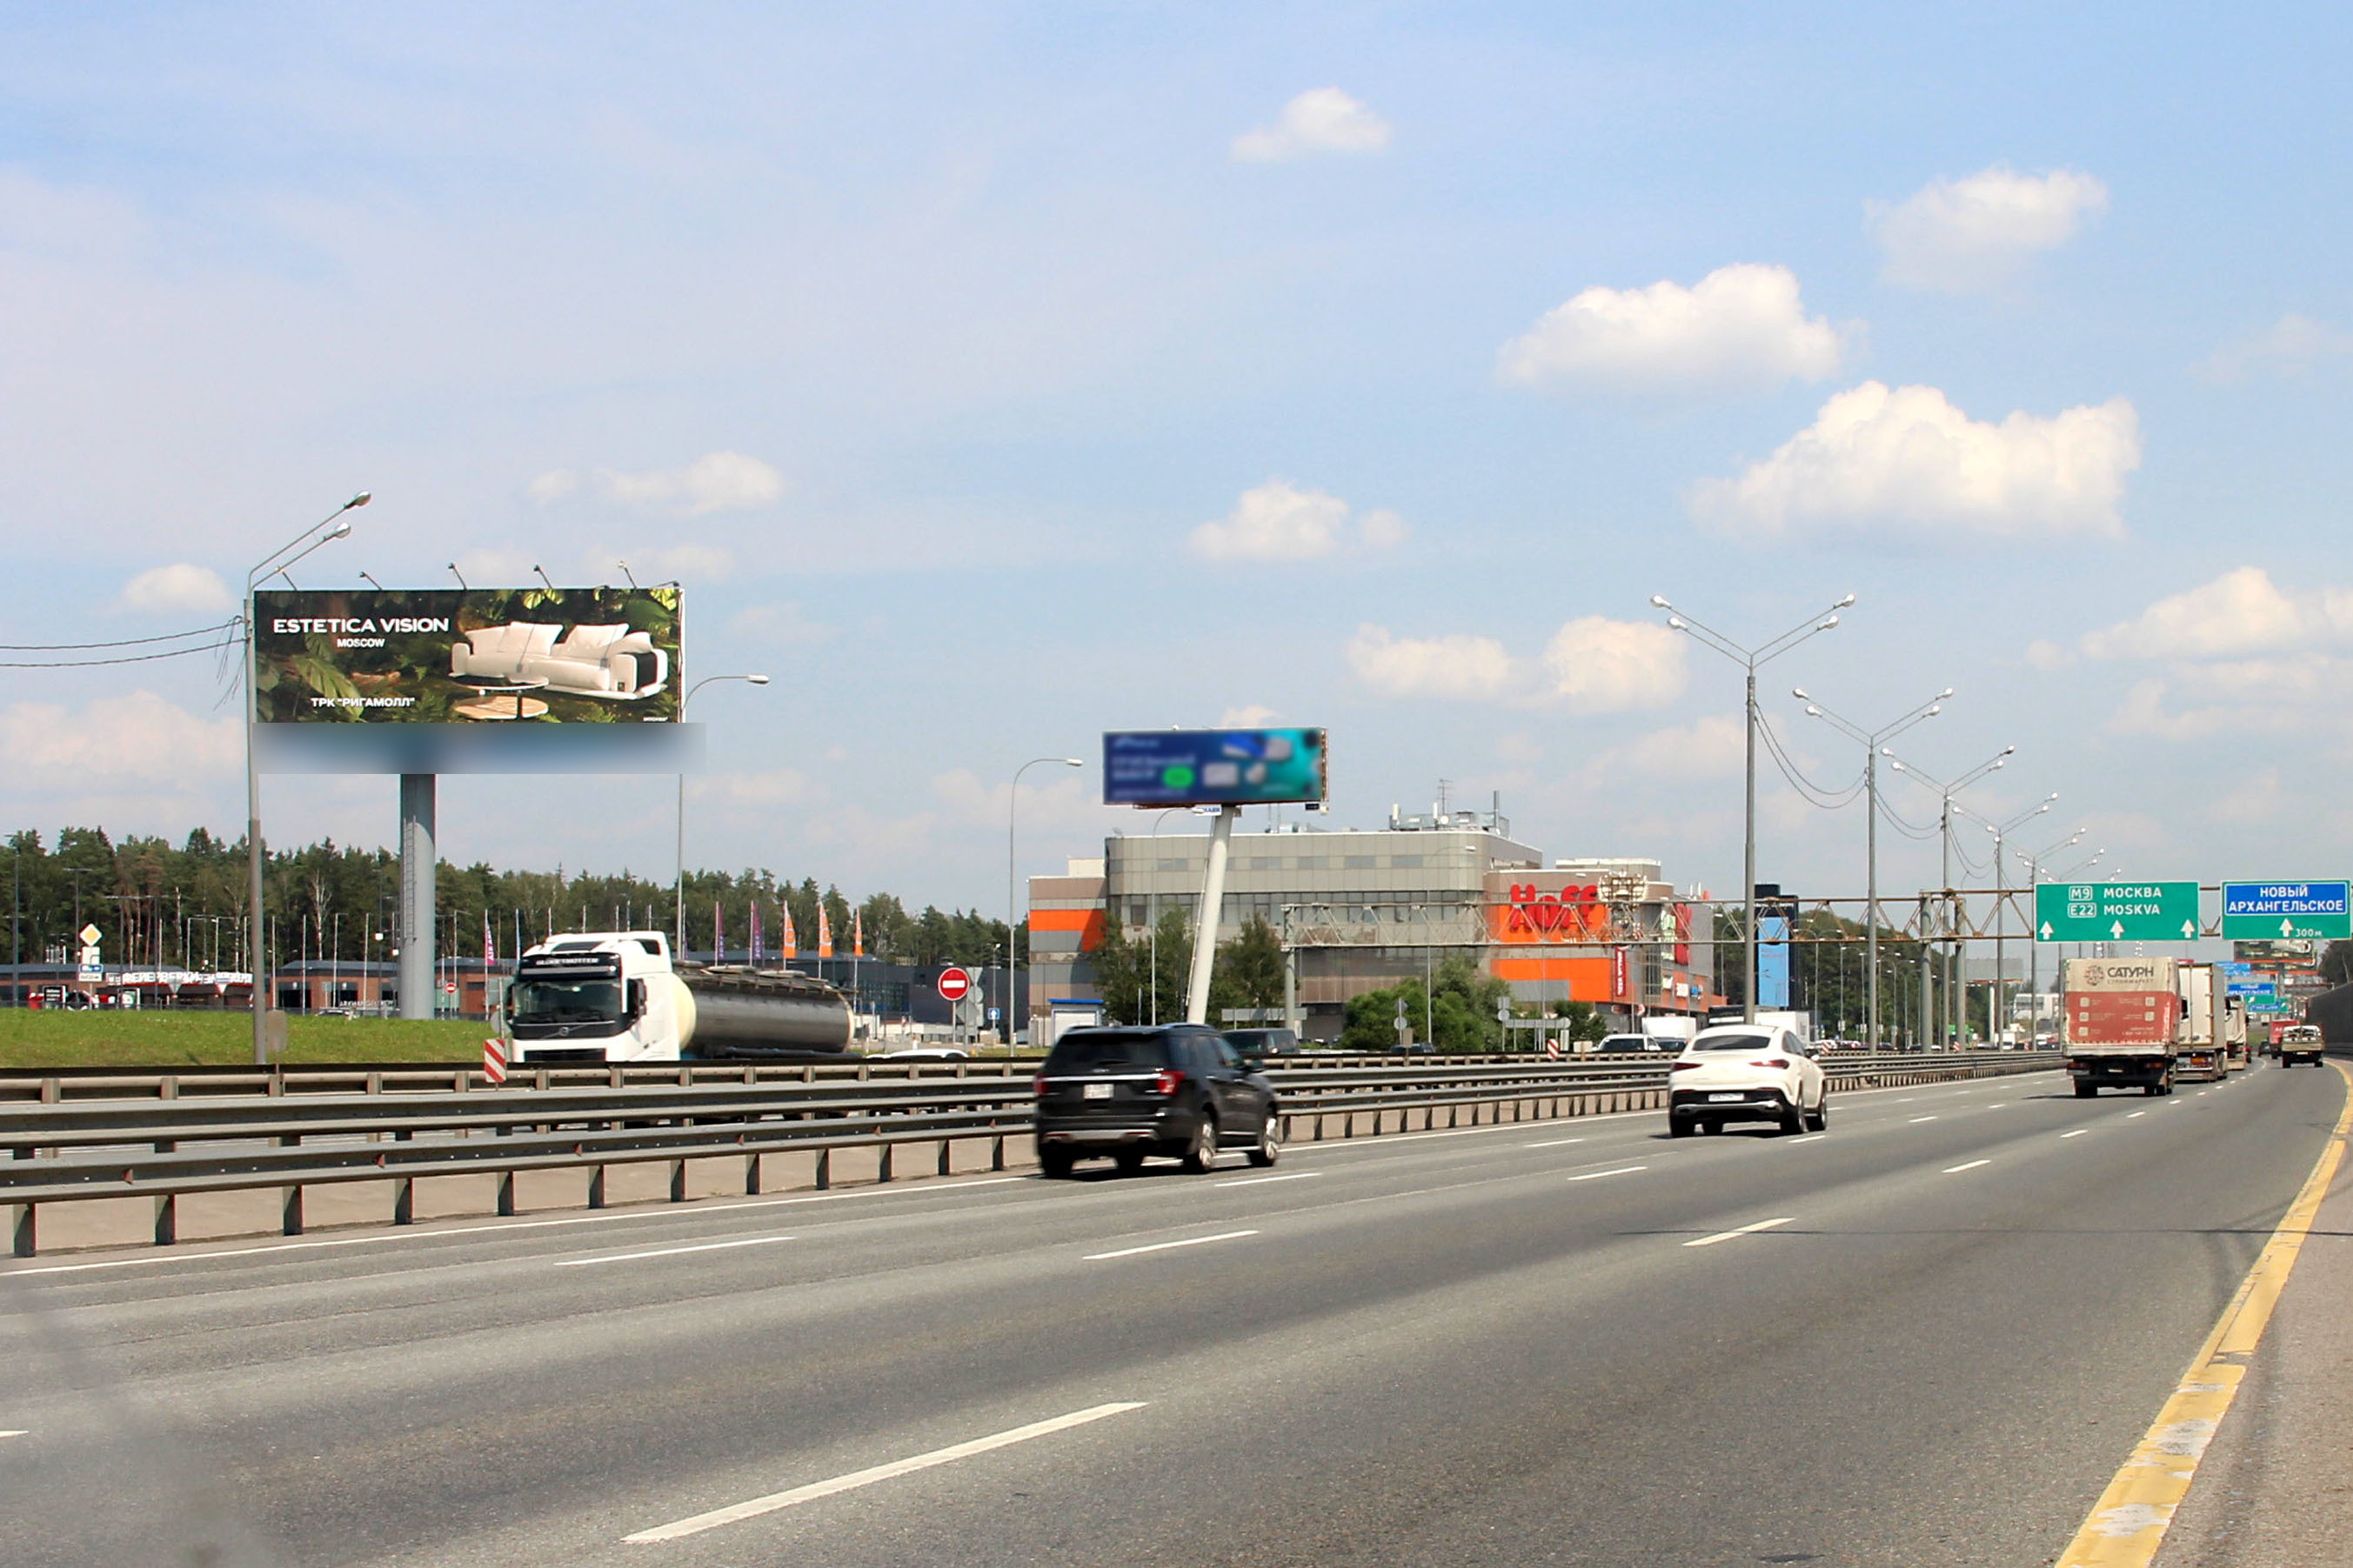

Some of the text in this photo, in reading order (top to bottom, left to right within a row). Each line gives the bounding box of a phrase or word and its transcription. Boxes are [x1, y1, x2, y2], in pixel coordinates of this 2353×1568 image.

[273, 617, 449, 633] ESTETICA VISION
[337, 638, 385, 648] MOSCOW
[311, 697, 416, 708] ТРК "РИГАМОЛЛ"
[2103, 886, 2162, 898] МОСКВА
[2259, 884, 2309, 898] НОВЫЙ
[2070, 904, 2095, 916] E22
[2103, 904, 2161, 916] MOSKVA
[2228, 899, 2344, 912] АРХАНГЕЛЬСКОЕ
[2107, 966, 2155, 977] САТУРН
